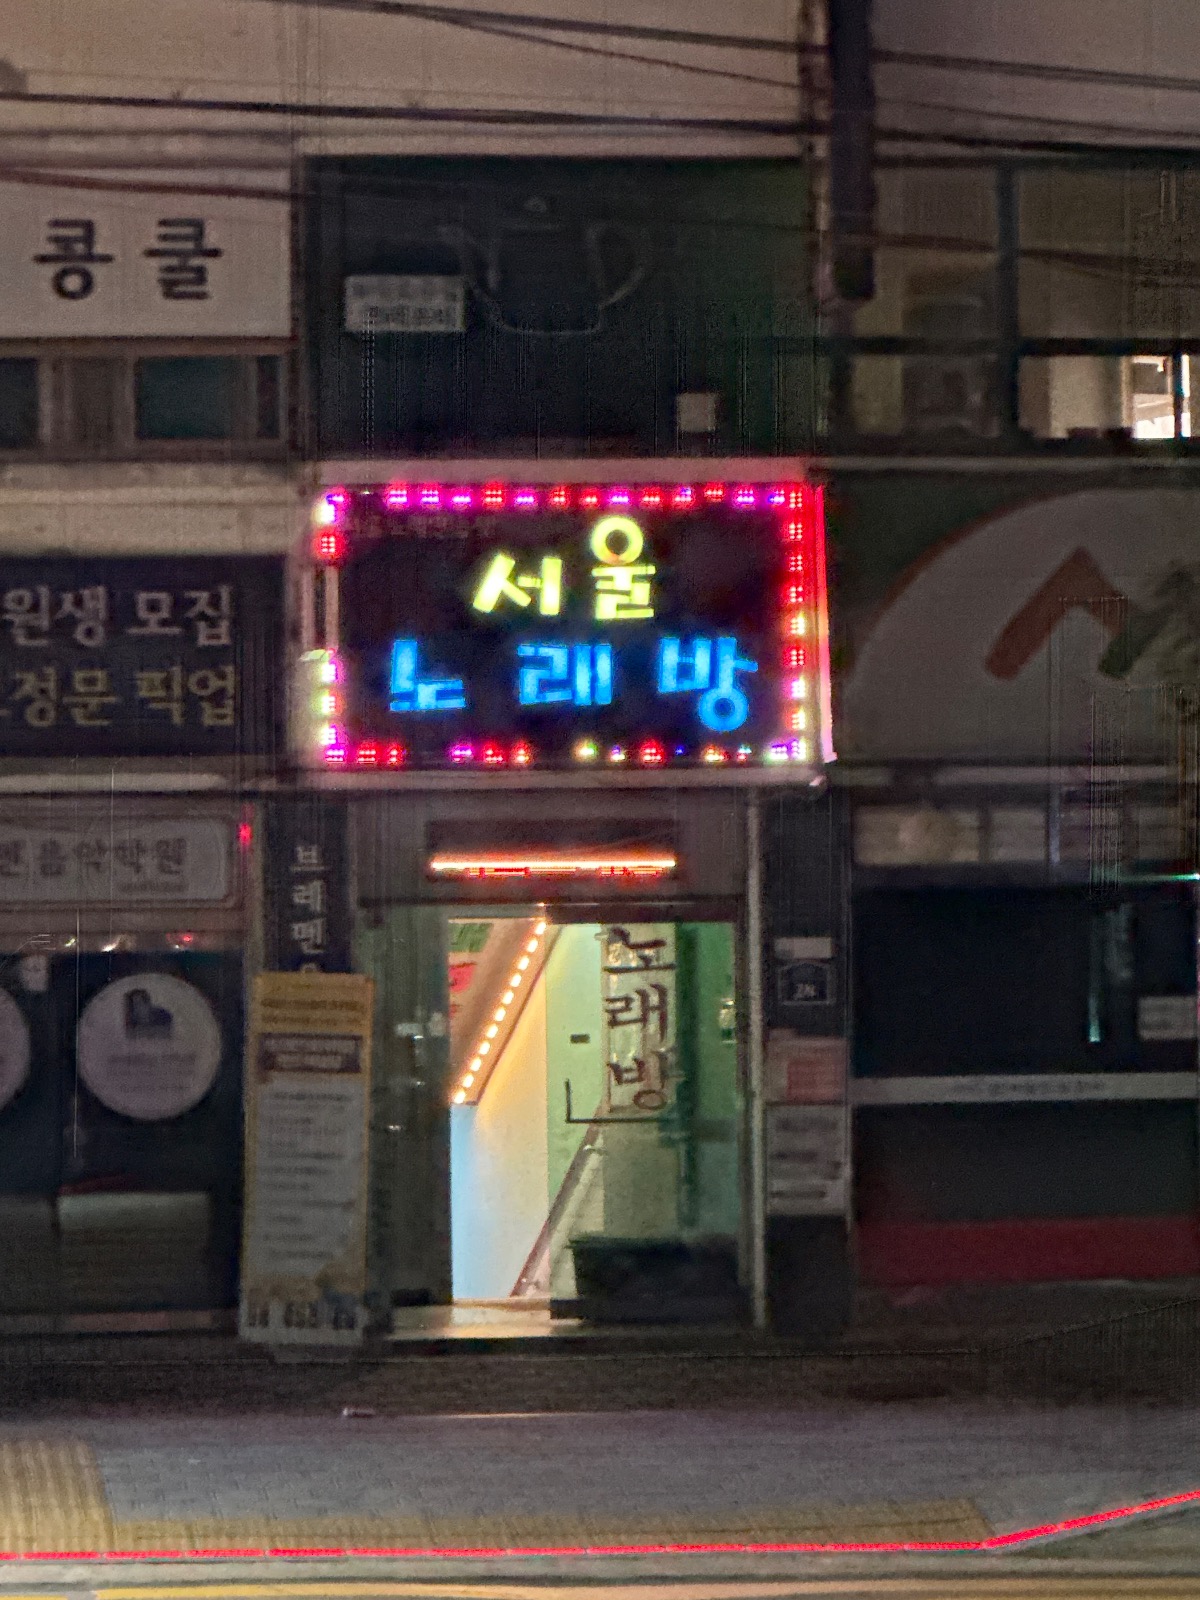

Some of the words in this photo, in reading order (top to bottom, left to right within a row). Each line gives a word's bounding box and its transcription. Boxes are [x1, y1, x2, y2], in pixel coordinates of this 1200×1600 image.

[471, 514, 658, 621] 서울
[1, 584, 108, 648] 원생
[125, 584, 233, 648] 모집
[135, 664, 236, 728] 픽업
[389, 636, 759, 733] 노래방
